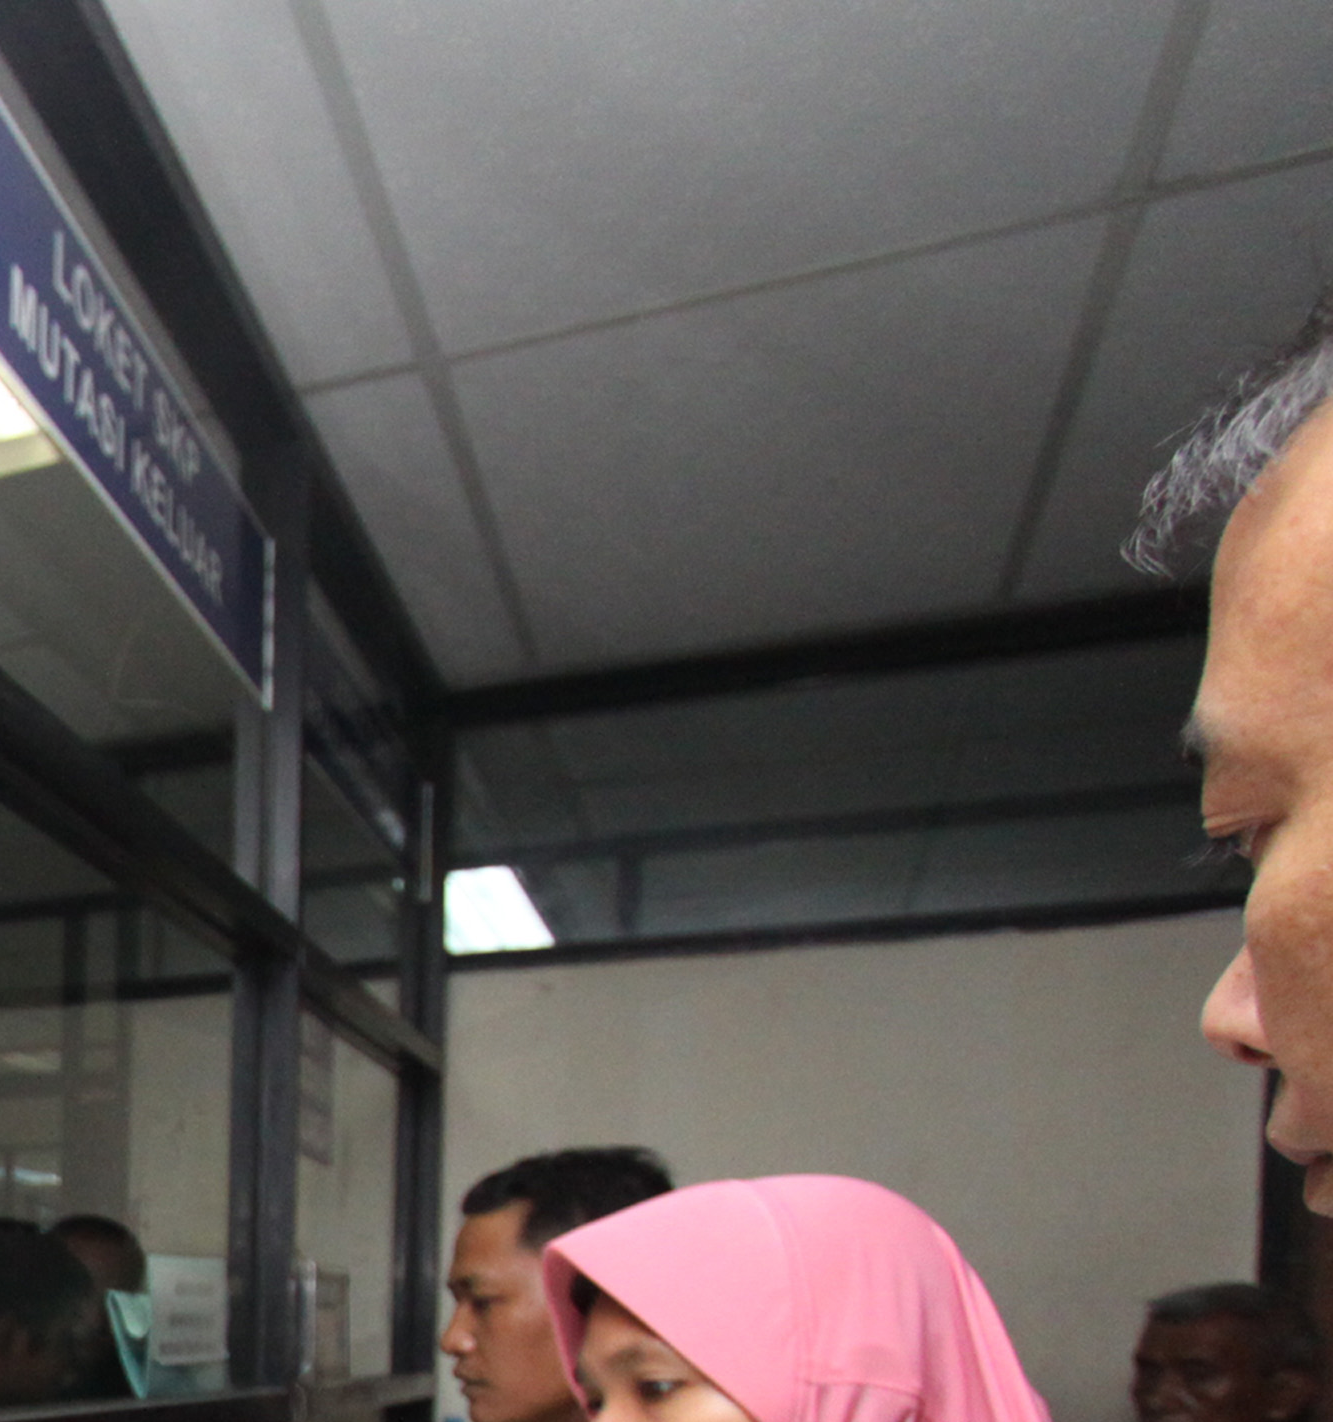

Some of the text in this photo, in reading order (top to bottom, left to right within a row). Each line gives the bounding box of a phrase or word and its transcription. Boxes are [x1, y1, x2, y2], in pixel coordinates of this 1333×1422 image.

[9, 264, 225, 607] MUTASI KELUAR
[53, 231, 148, 411] LOKET
